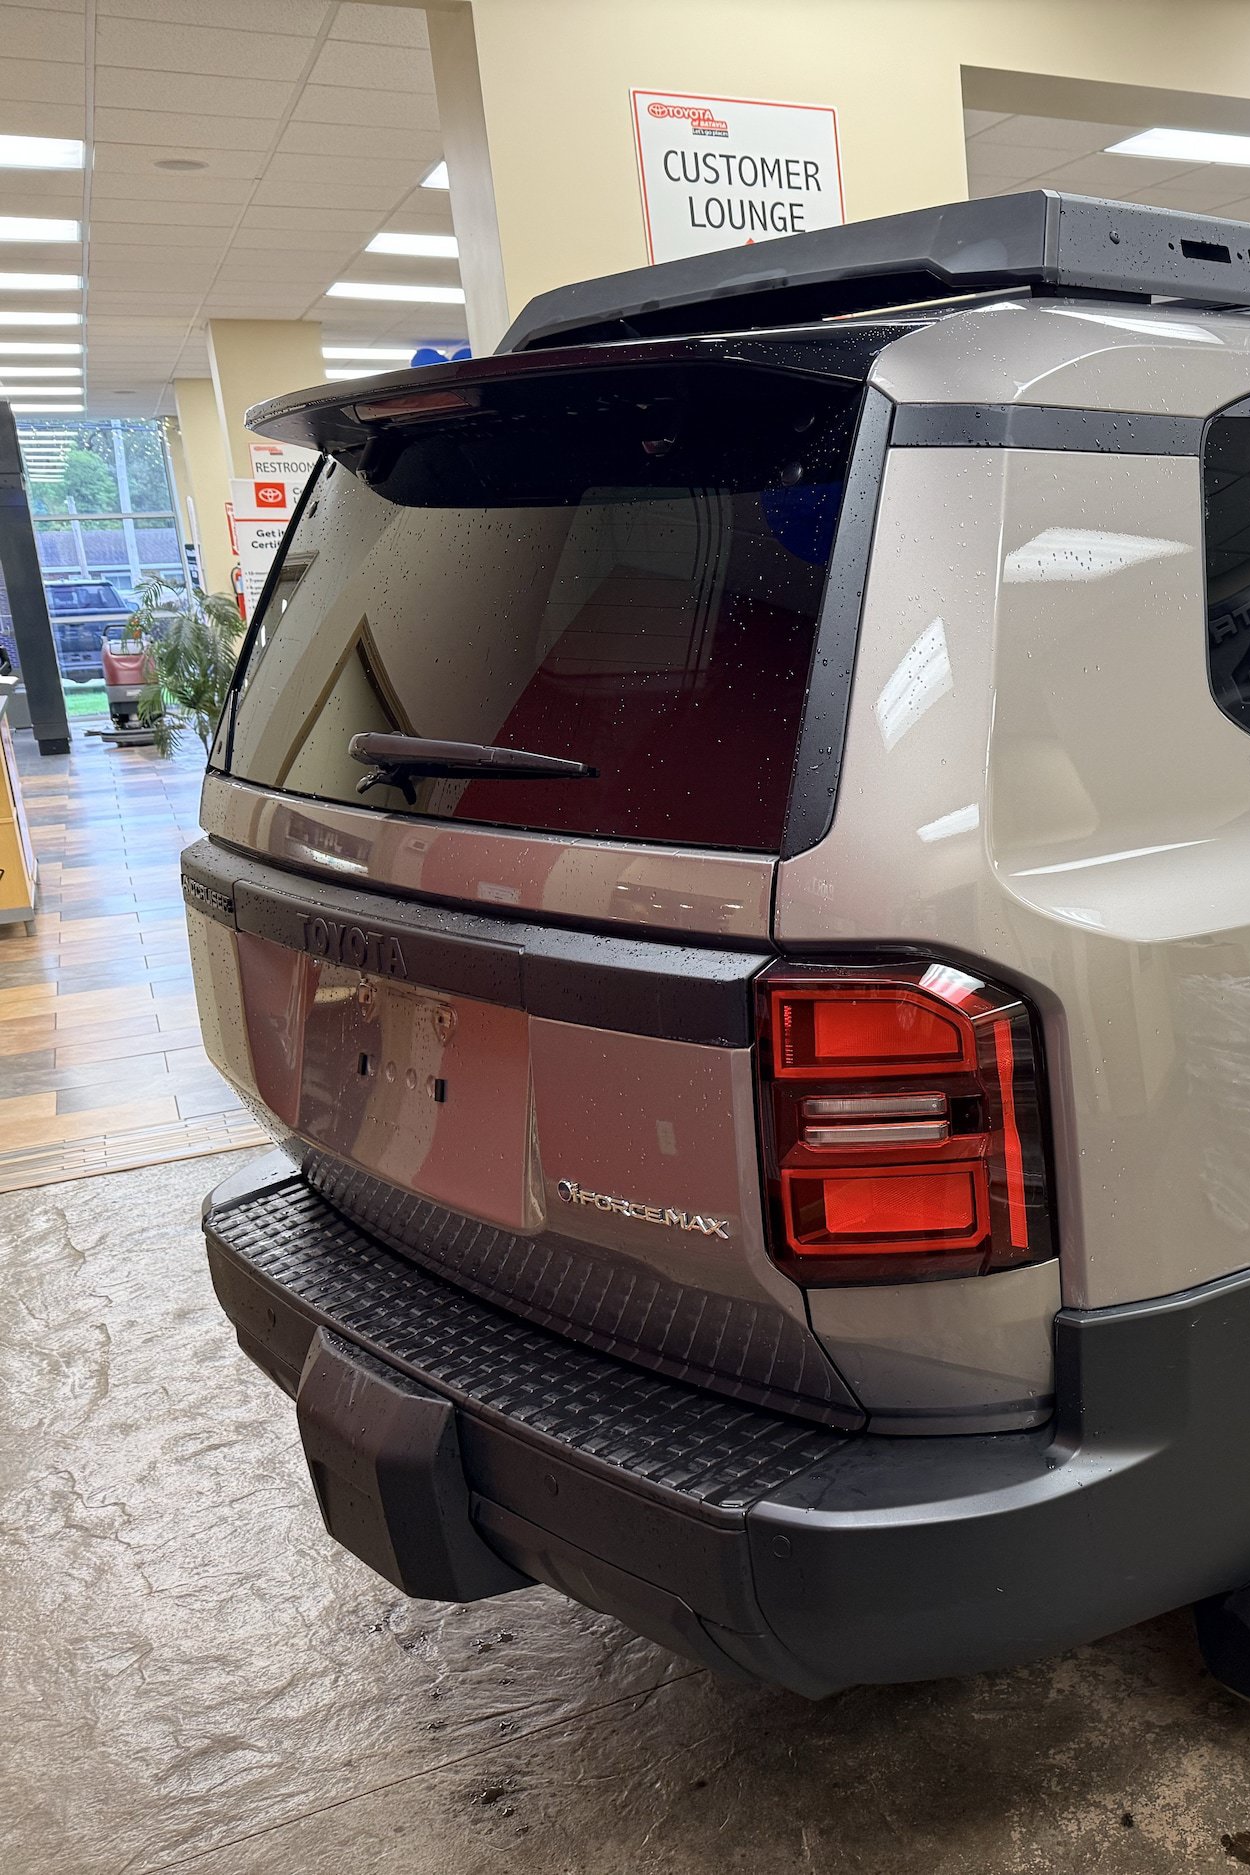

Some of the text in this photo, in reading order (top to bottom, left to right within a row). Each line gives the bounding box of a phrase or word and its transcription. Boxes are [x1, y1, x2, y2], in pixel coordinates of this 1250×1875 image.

[666, 107, 713, 120] TOYOTA
[700, 120, 727, 129] BATAVIA
[663, 149, 822, 192] CUSTOMER
[688, 195, 806, 233] LOUNGE
[256, 529, 276, 538] Get
[296, 912, 408, 979] TOYOTA
